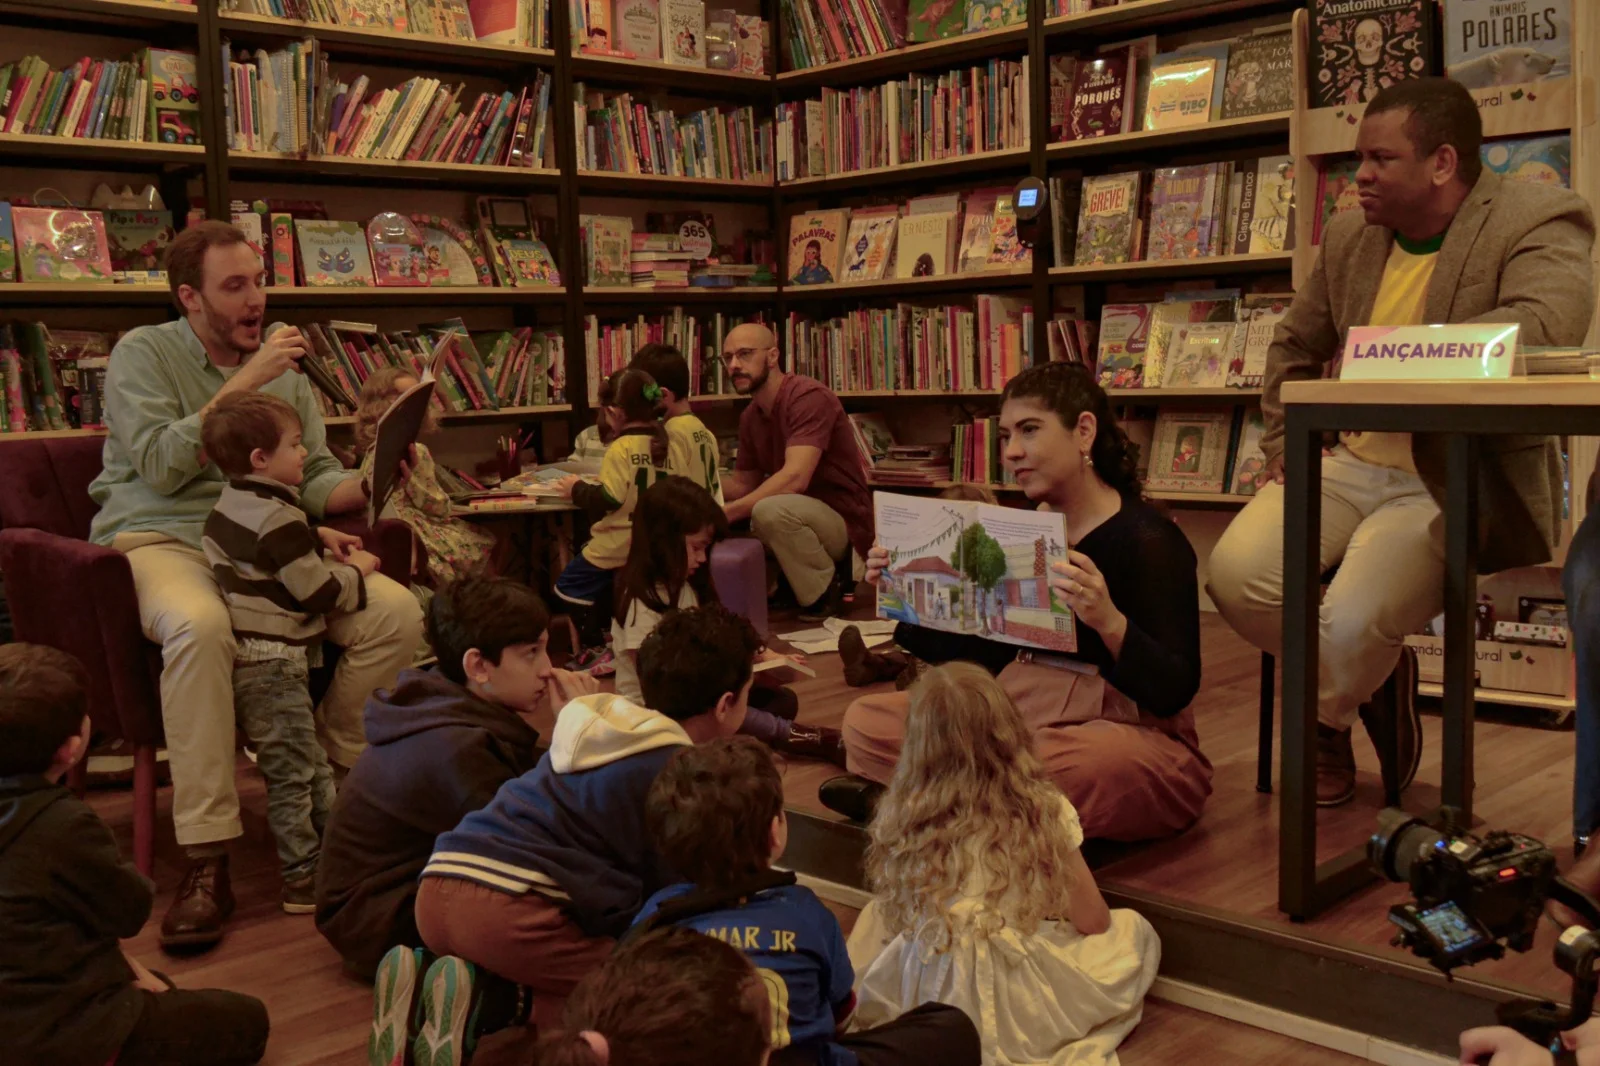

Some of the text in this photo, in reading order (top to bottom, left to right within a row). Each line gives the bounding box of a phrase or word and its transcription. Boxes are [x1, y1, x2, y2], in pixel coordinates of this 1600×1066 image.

[1490, 2, 1527, 17] ANIMAIS
[1462, 7, 1557, 53] POLARES
[1267, 59, 1292, 70] MAR
[1475, 92, 1503, 108] ural
[1090, 187, 1125, 215] GREVE!
[1237, 171, 1254, 242] Cisne Branco
[682, 225, 706, 239] 365
[902, 217, 945, 237] ERNESTO
[792, 227, 837, 248] PALAVRAS
[1352, 342, 1506, 362] LANÇAMENTO
[631, 453, 674, 471] BRIL
[1413, 644, 1502, 662] anda ural
[706, 926, 797, 952] MAR JR
